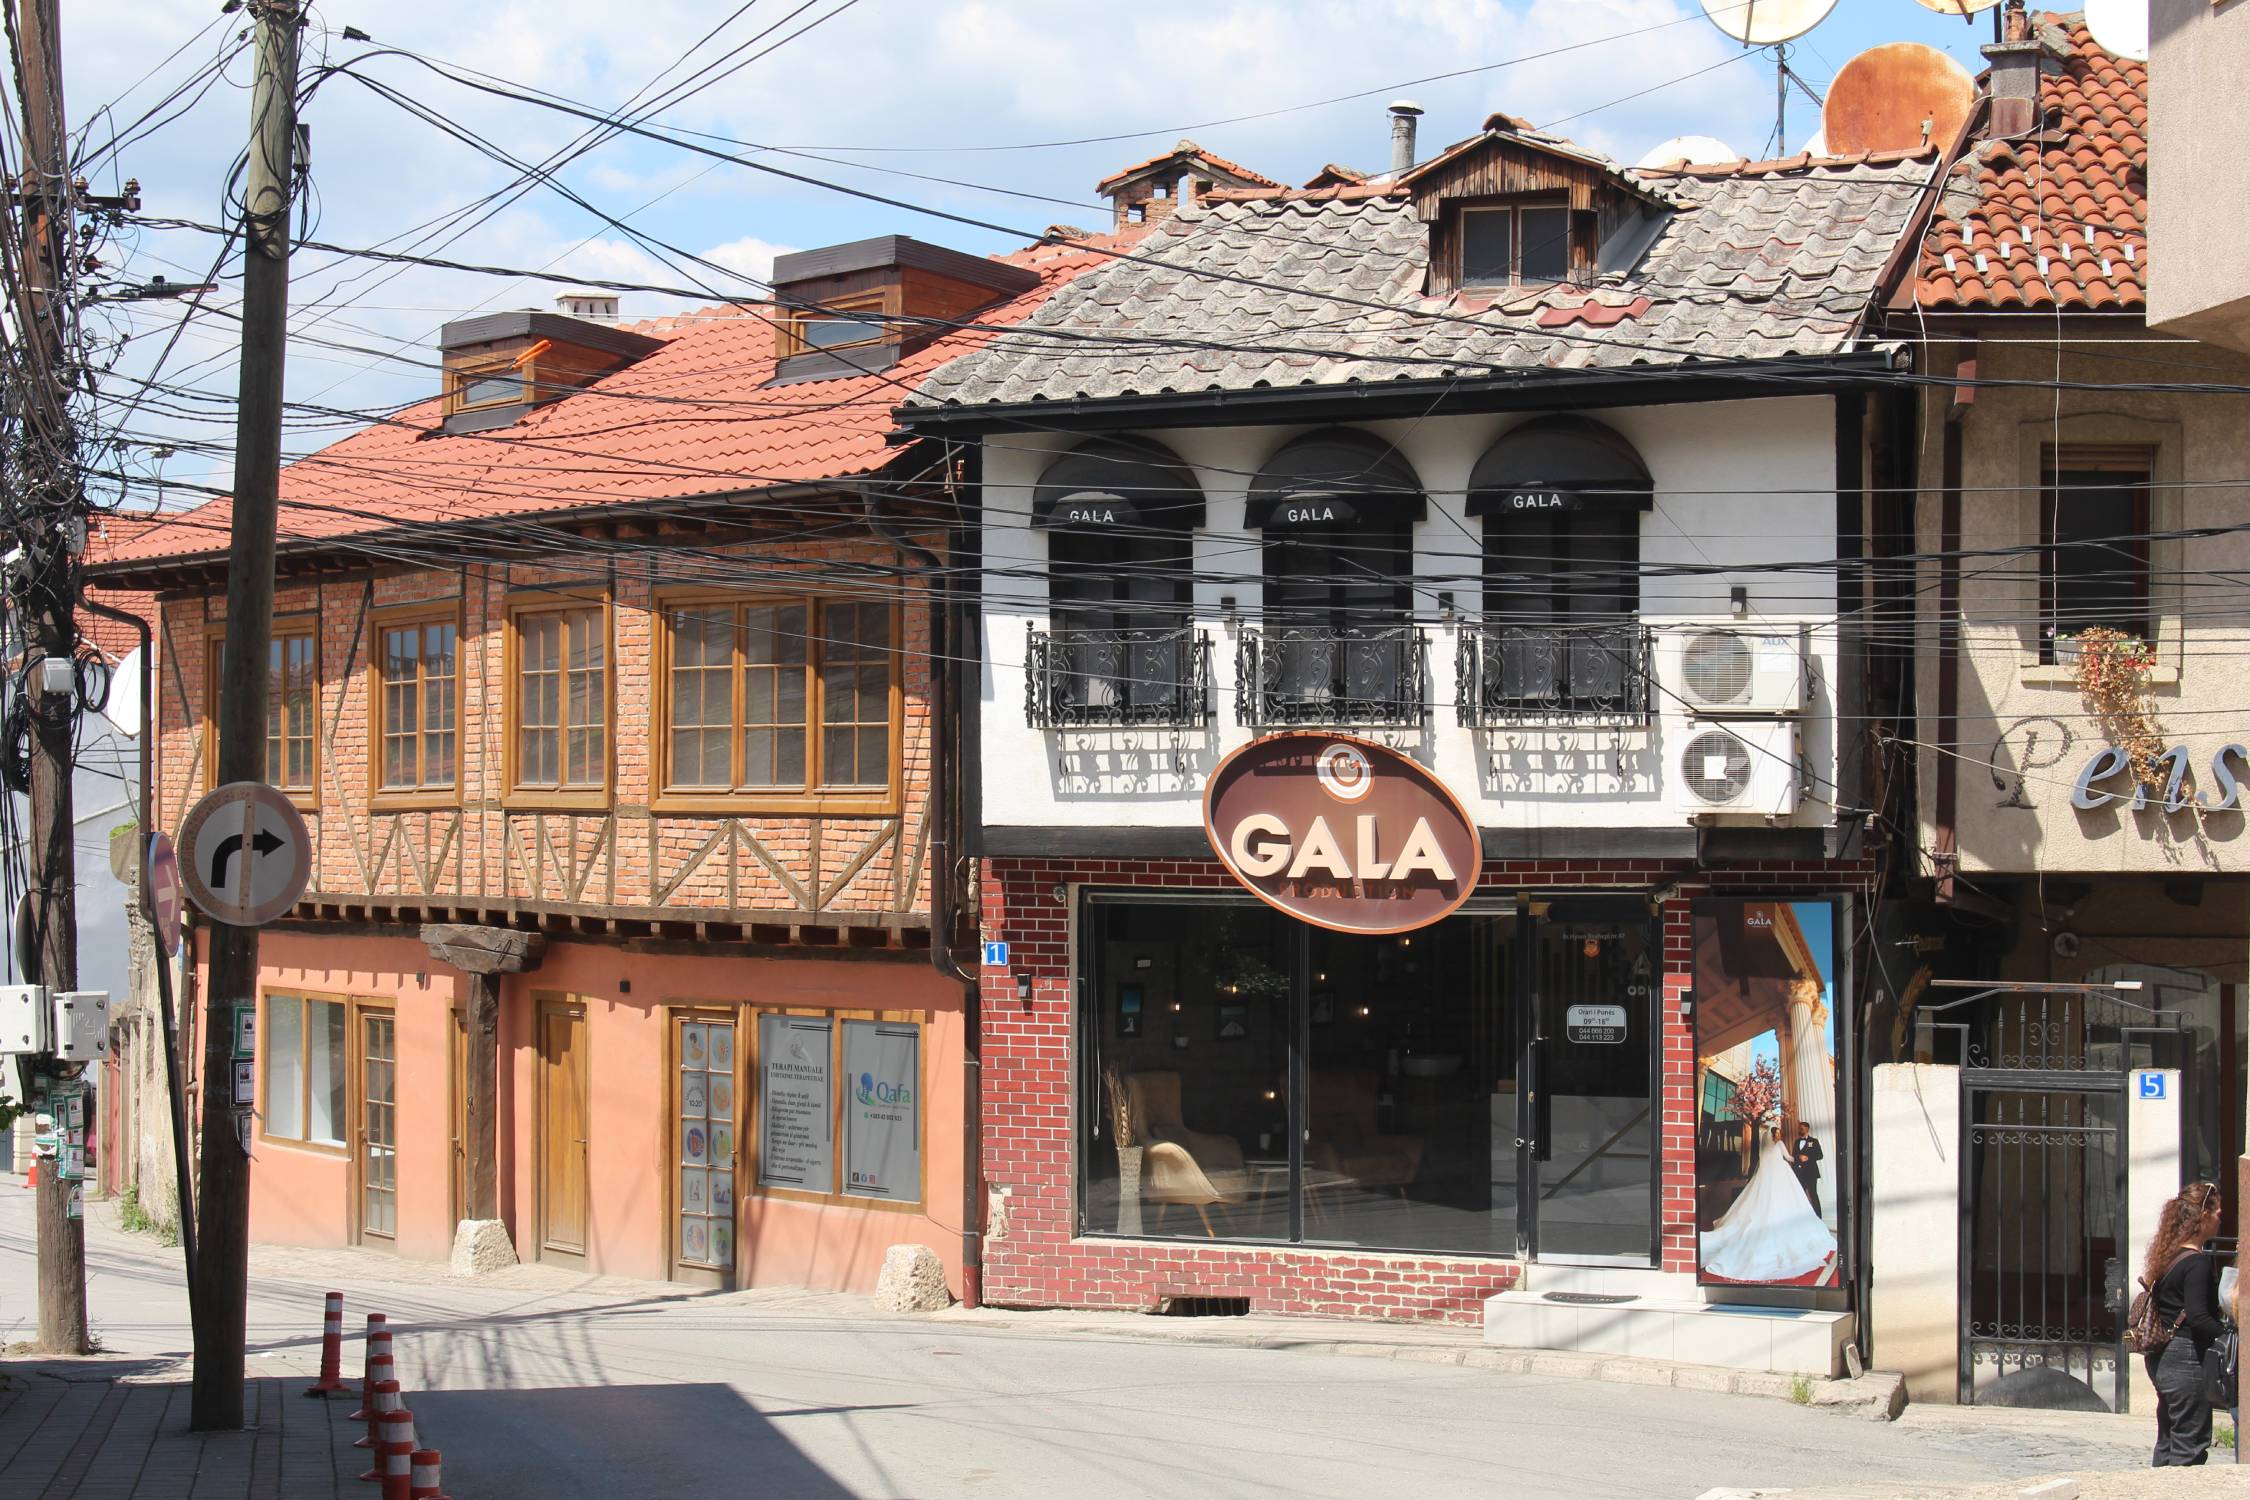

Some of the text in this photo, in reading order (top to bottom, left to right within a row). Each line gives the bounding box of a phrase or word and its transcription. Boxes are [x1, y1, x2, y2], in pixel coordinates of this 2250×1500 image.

[1513, 493, 1562, 508] GALA
[1069, 509, 1115, 523] GALA
[1287, 507, 1334, 522] GALA
[1230, 813, 1457, 881] GALA
[1747, 917, 1772, 925] GALA
[990, 944, 1003, 964] 1
[771, 1062, 824, 1075] TERAPI MANUALE
[876, 1081, 911, 1104] Qafa
[2145, 1074, 2160, 1097] 5
